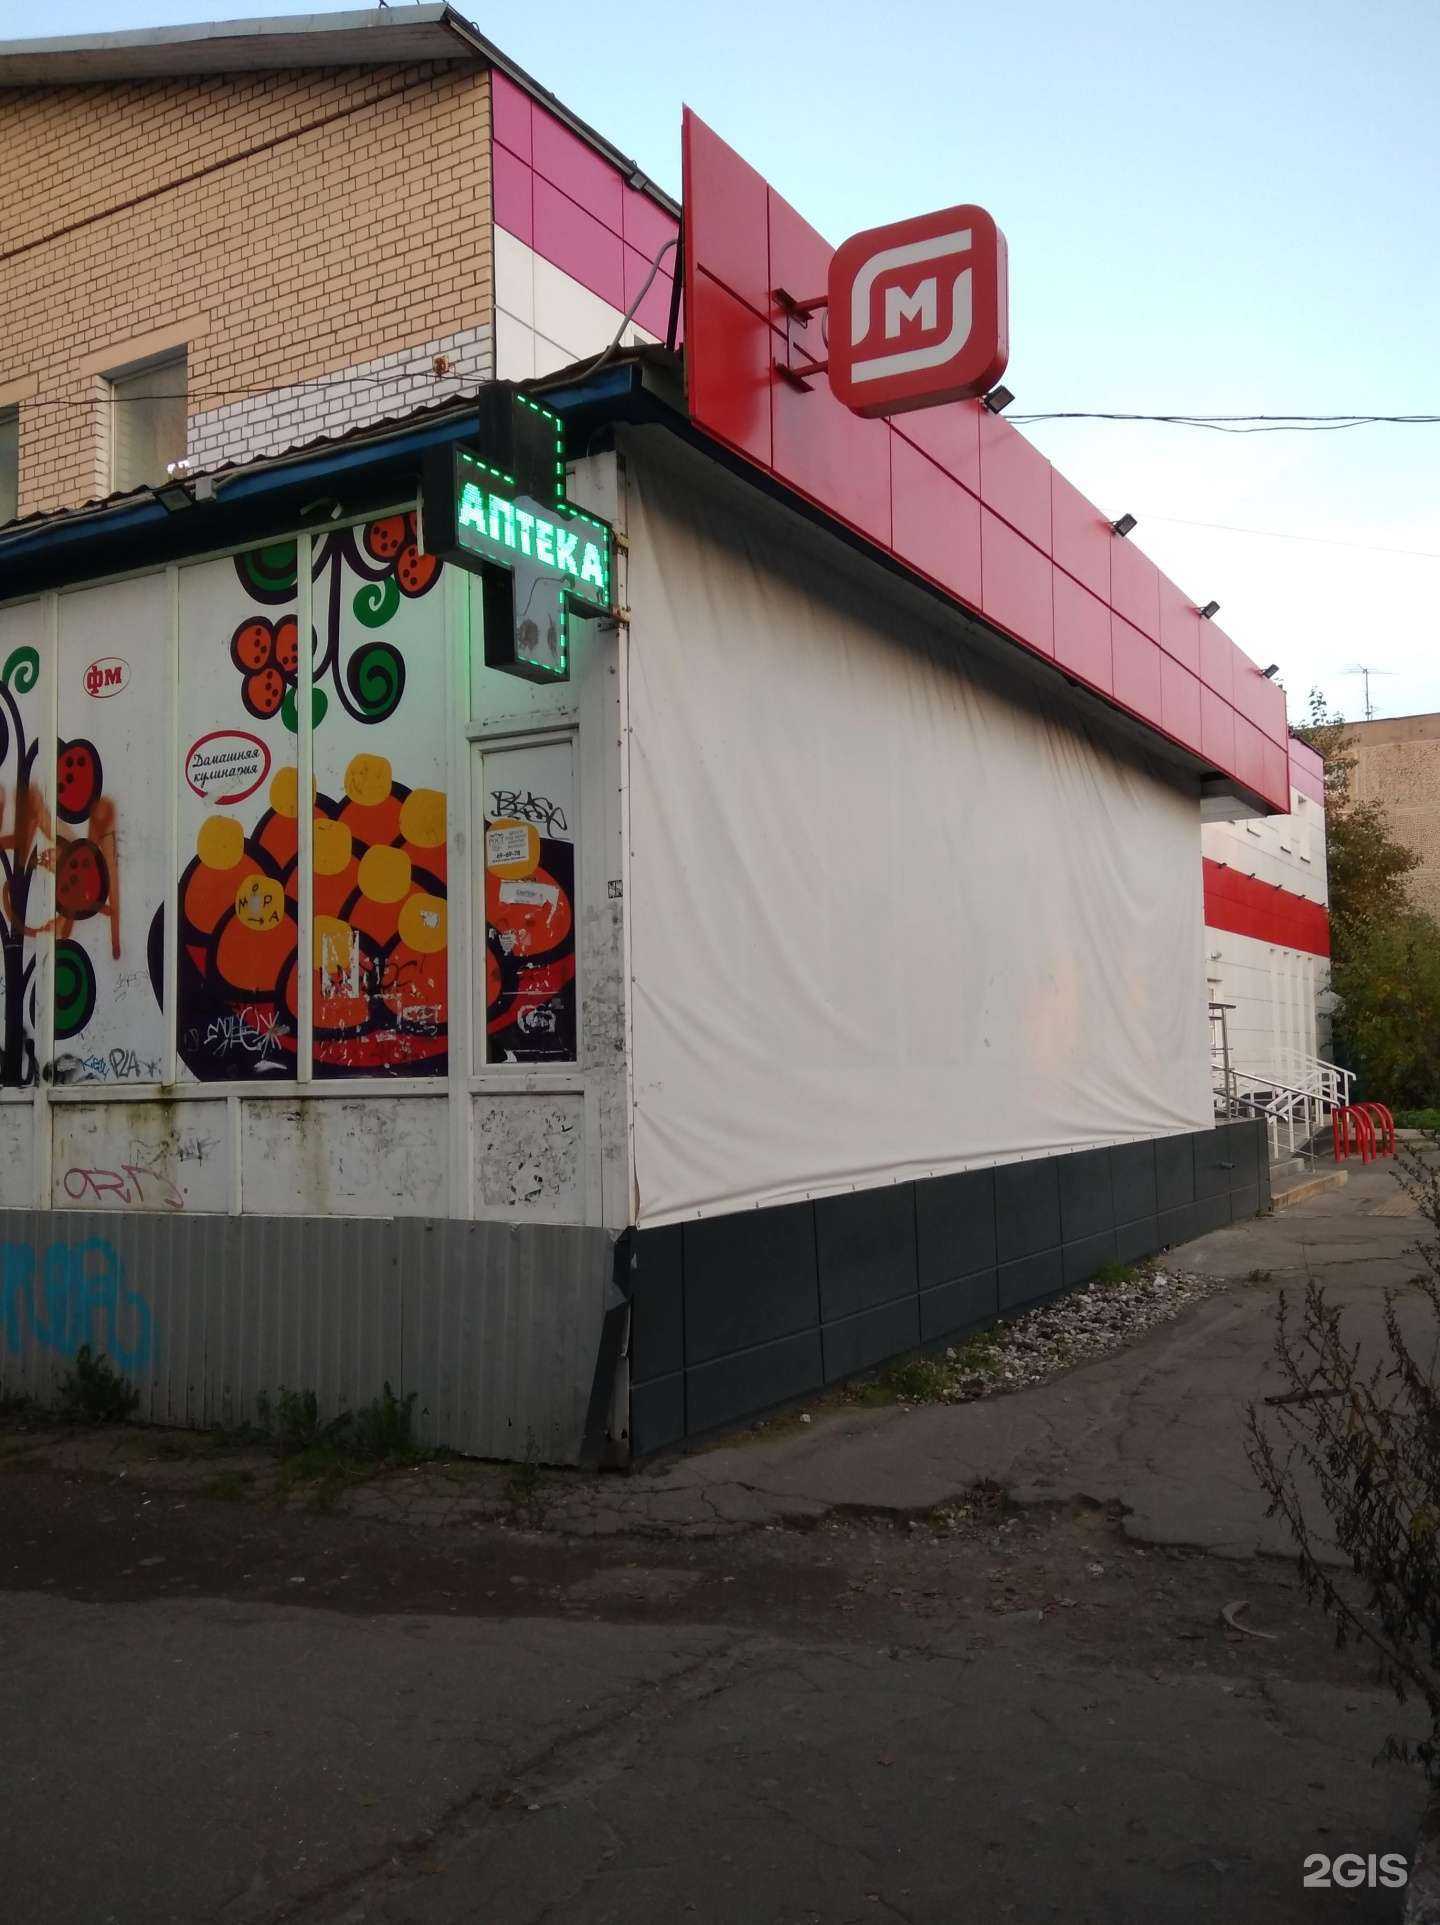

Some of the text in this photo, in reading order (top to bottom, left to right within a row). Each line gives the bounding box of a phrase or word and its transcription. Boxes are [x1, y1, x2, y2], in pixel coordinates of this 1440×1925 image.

[458, 482, 605, 588] АПТЕКА
[86, 665, 122, 694] ФМ
[192, 748, 260, 768] Домашняя
